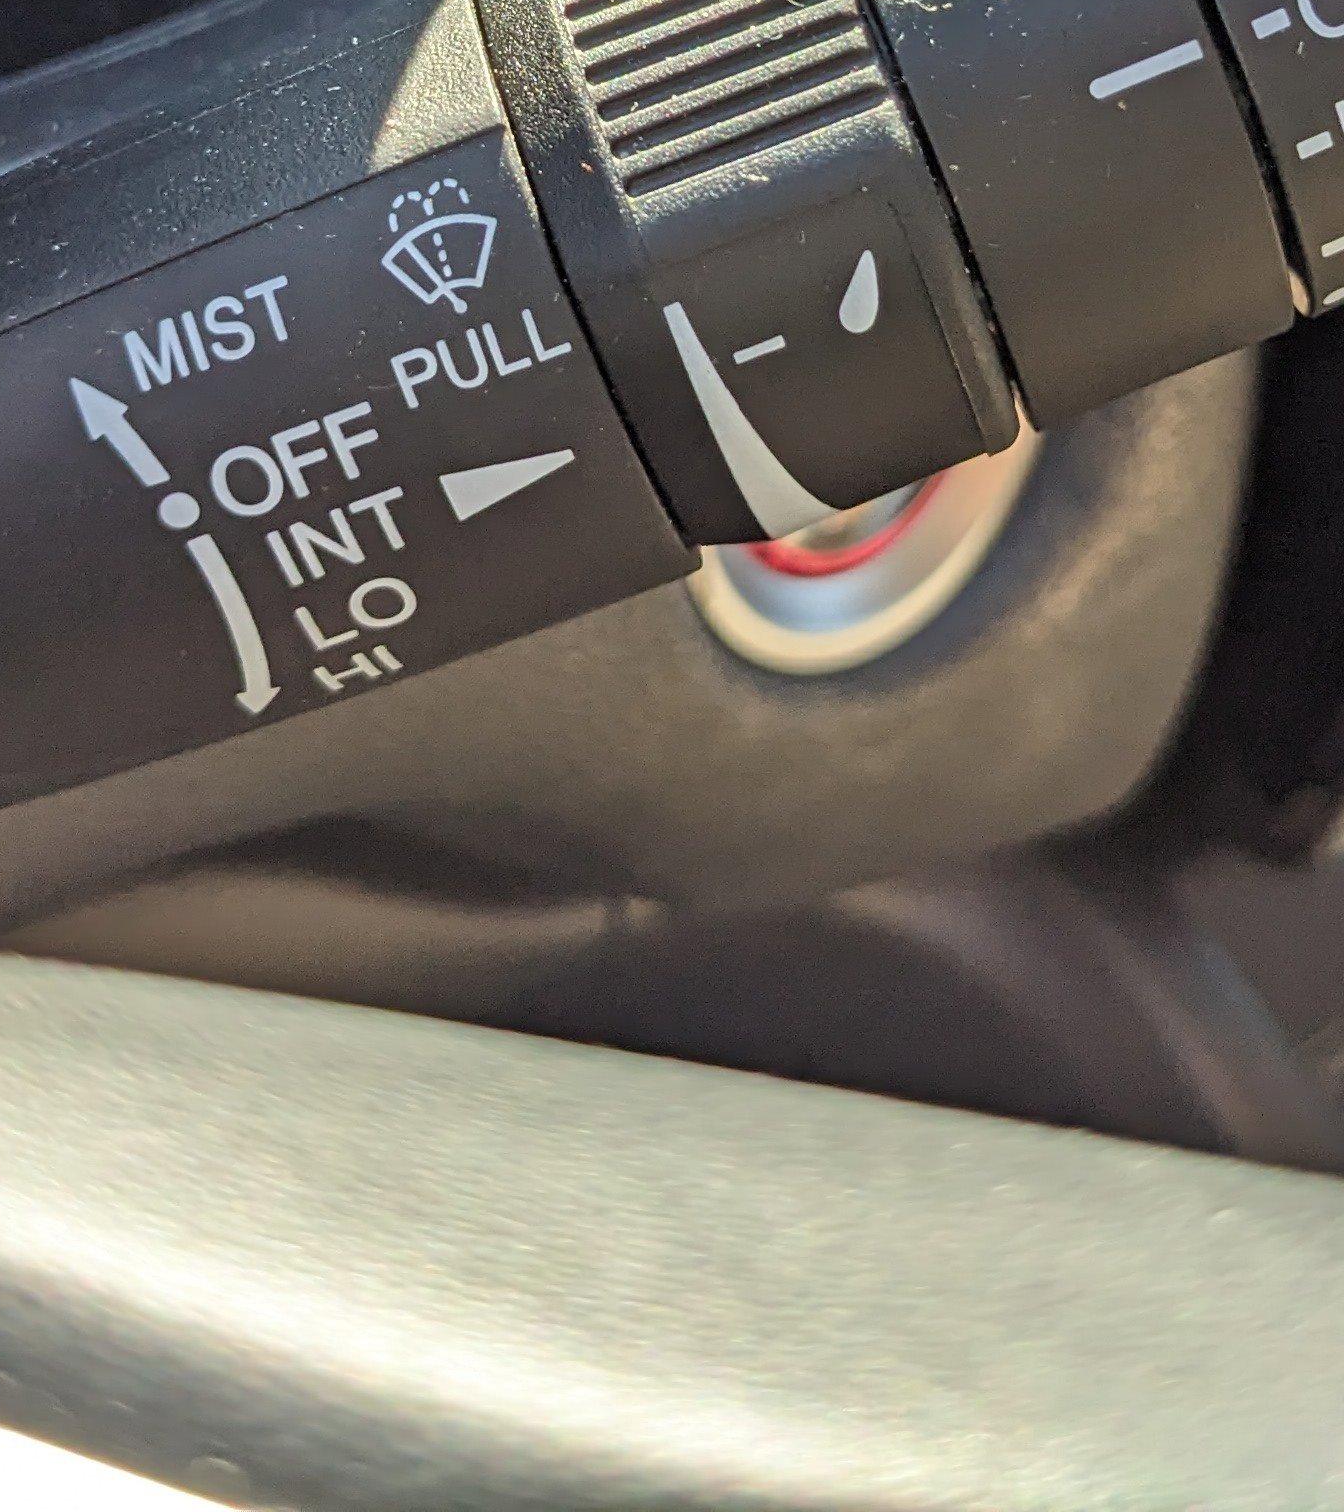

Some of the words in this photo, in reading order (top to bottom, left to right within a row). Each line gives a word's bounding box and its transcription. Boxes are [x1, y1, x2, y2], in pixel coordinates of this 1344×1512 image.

[124, 275, 289, 391] MIST
[391, 309, 571, 409] PULL
[210, 402, 379, 518] OFF
[267, 487, 406, 587] INT
[294, 577, 417, 651] LO
[314, 645, 403, 690] HI
